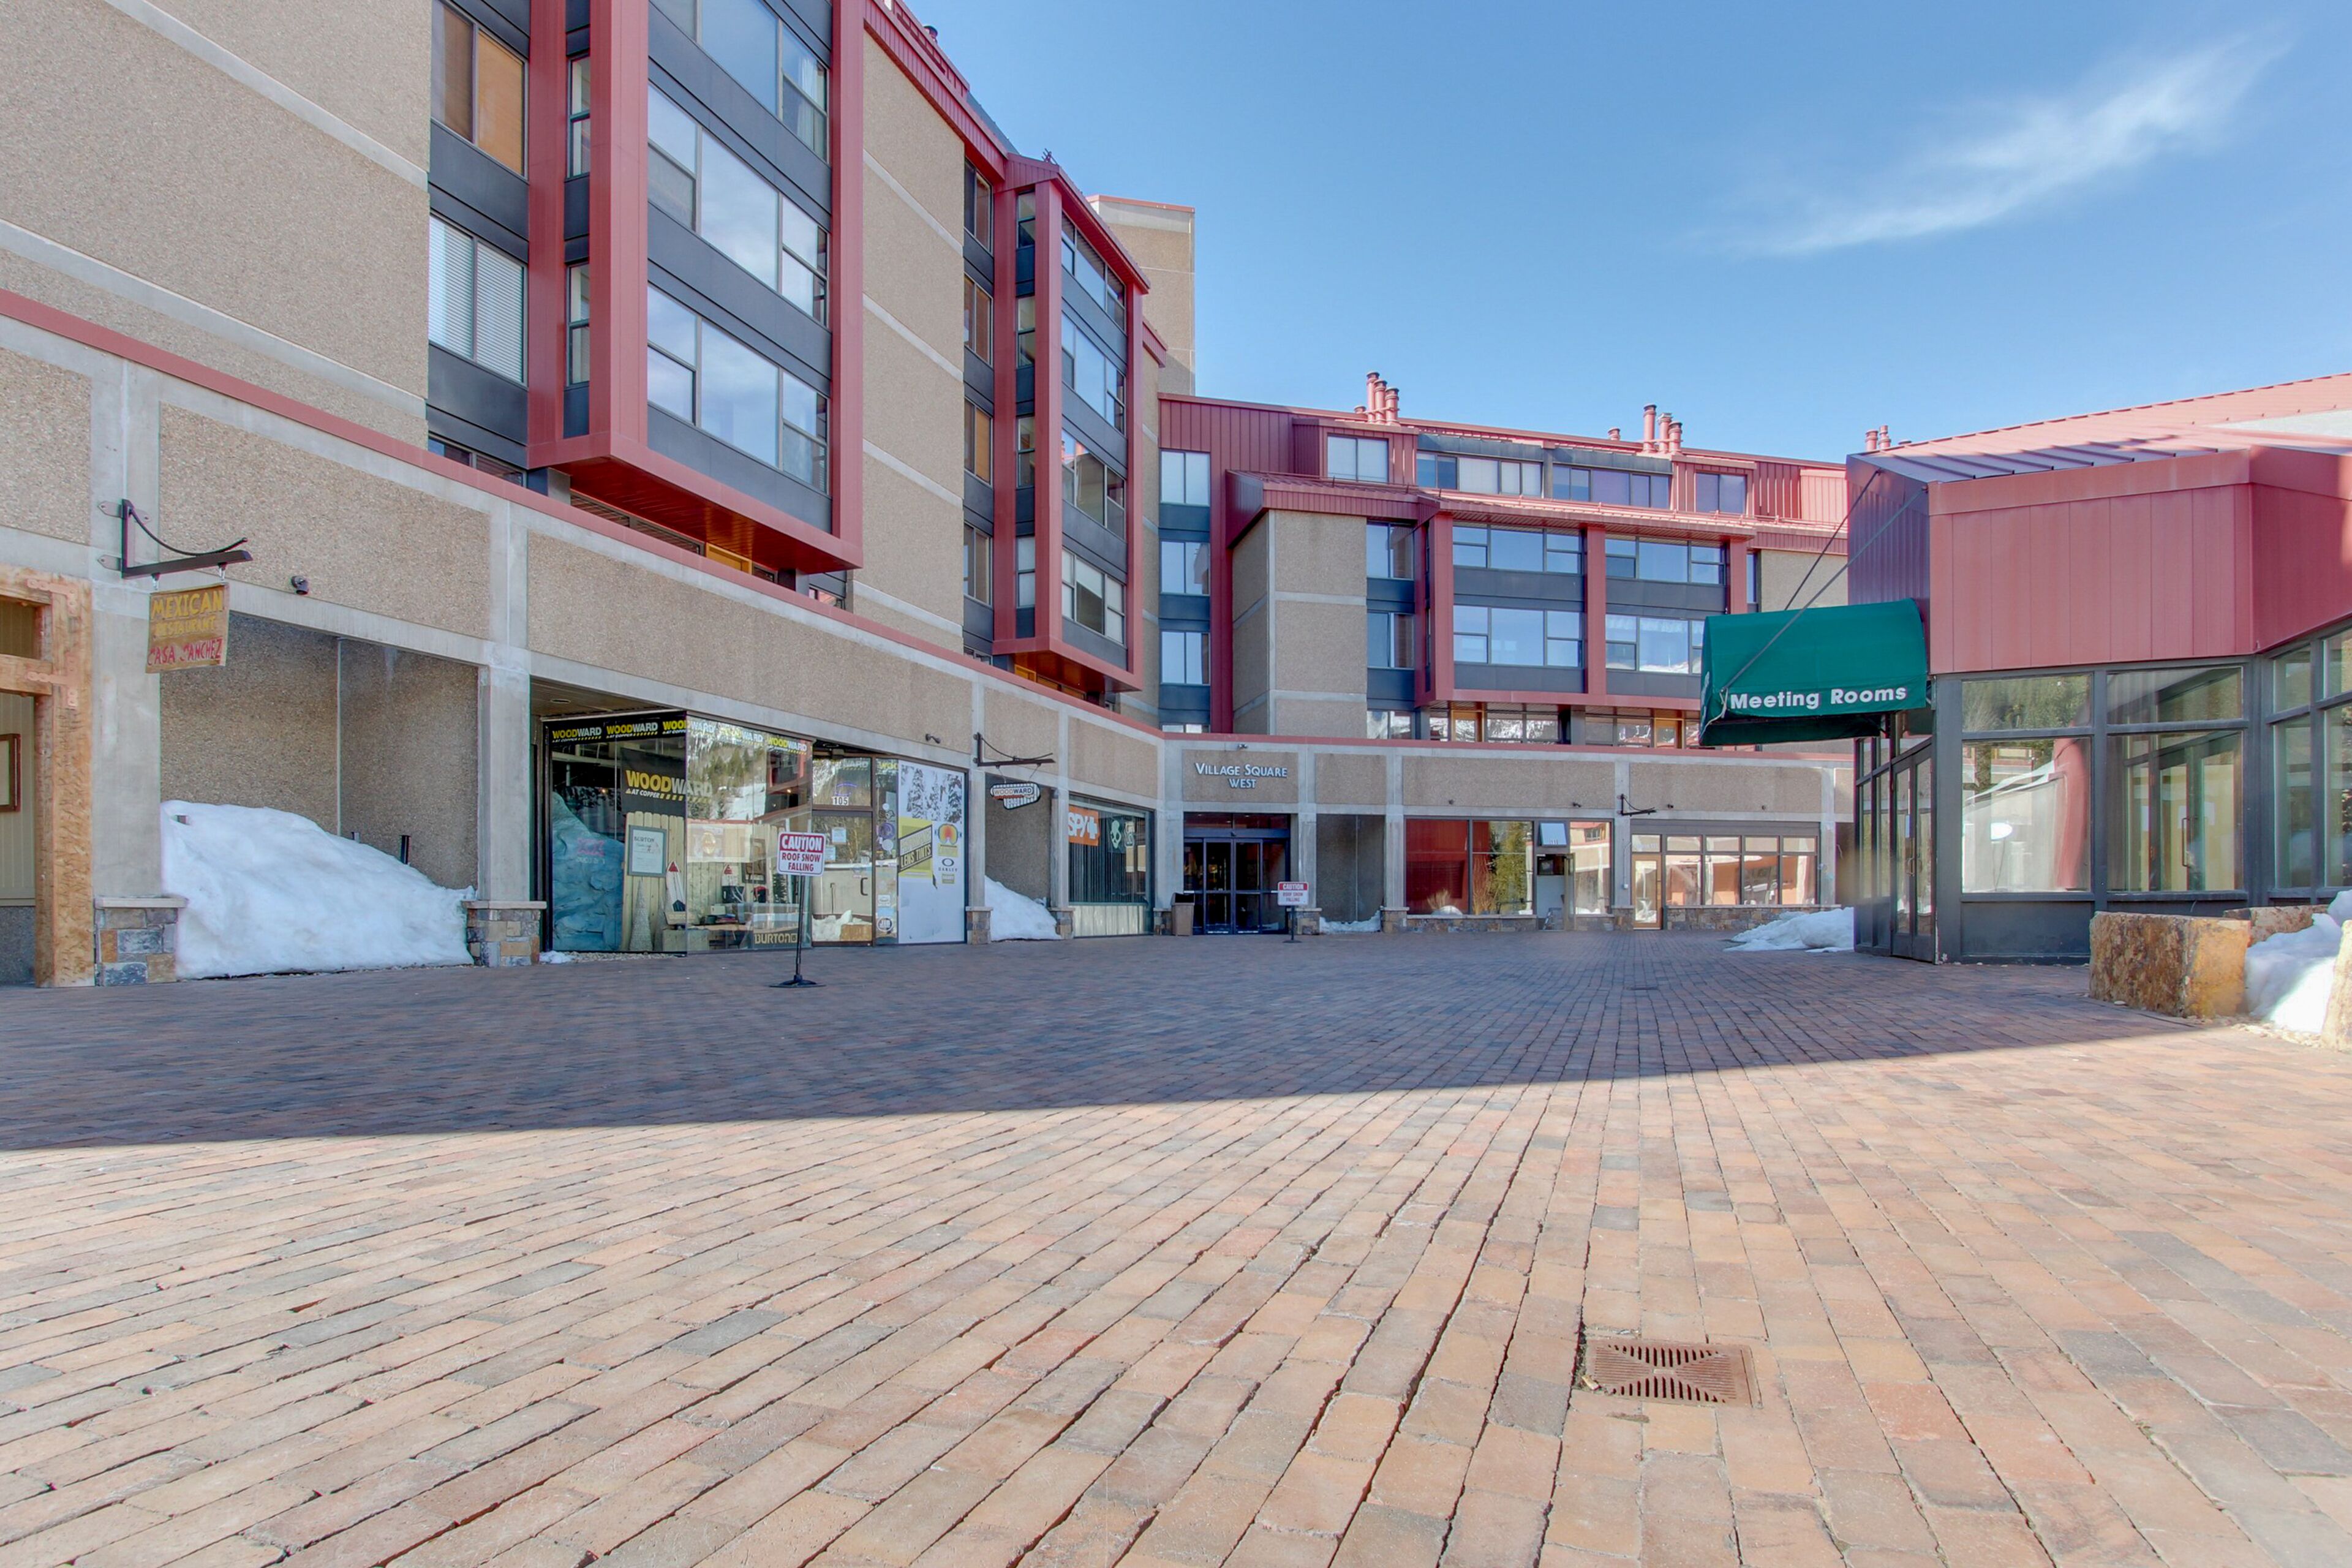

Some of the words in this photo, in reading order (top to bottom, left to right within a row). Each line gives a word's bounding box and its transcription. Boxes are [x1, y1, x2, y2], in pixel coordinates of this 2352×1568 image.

[151, 590, 224, 619] MEXICAN
[147, 645, 175, 666] CASA
[179, 637, 222, 662] SANCHEZ
[1730, 690, 1820, 709] Meeting
[1830, 687, 1907, 704] Rooms
[552, 726, 602, 739] WOODWARD
[606, 722, 658, 734] WOODWARD
[767, 737, 807, 752] WOODWARD
[625, 770, 713, 797] WOODWARD
[1229, 778, 1256, 788] WEST
[639, 790, 660, 799] COPPER
[782, 835, 823, 851] CAUTION
[802, 854, 821, 862] SNOW
[901, 852, 915, 868] LENS
[788, 862, 814, 872] FALLING
